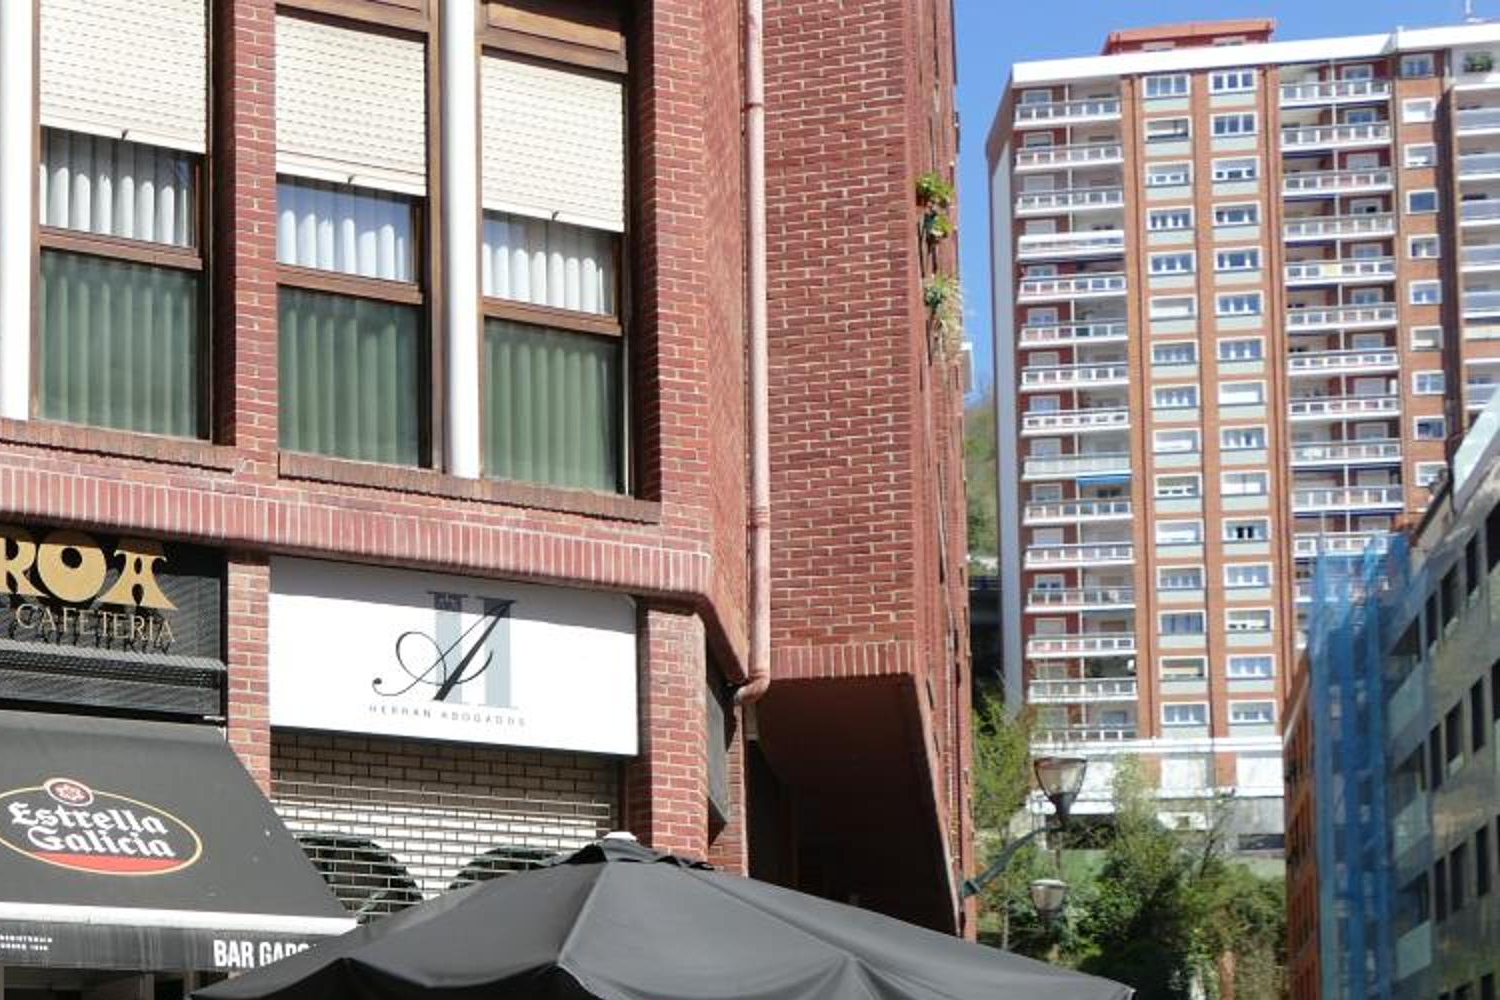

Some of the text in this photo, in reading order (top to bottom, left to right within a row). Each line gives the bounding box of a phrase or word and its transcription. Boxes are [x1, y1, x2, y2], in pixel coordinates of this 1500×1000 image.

[15, 603, 177, 642] CAFETERIA
[7, 801, 169, 835] Estrella
[27, 825, 176, 857] Galicia
[213, 939, 255, 968] BAR
